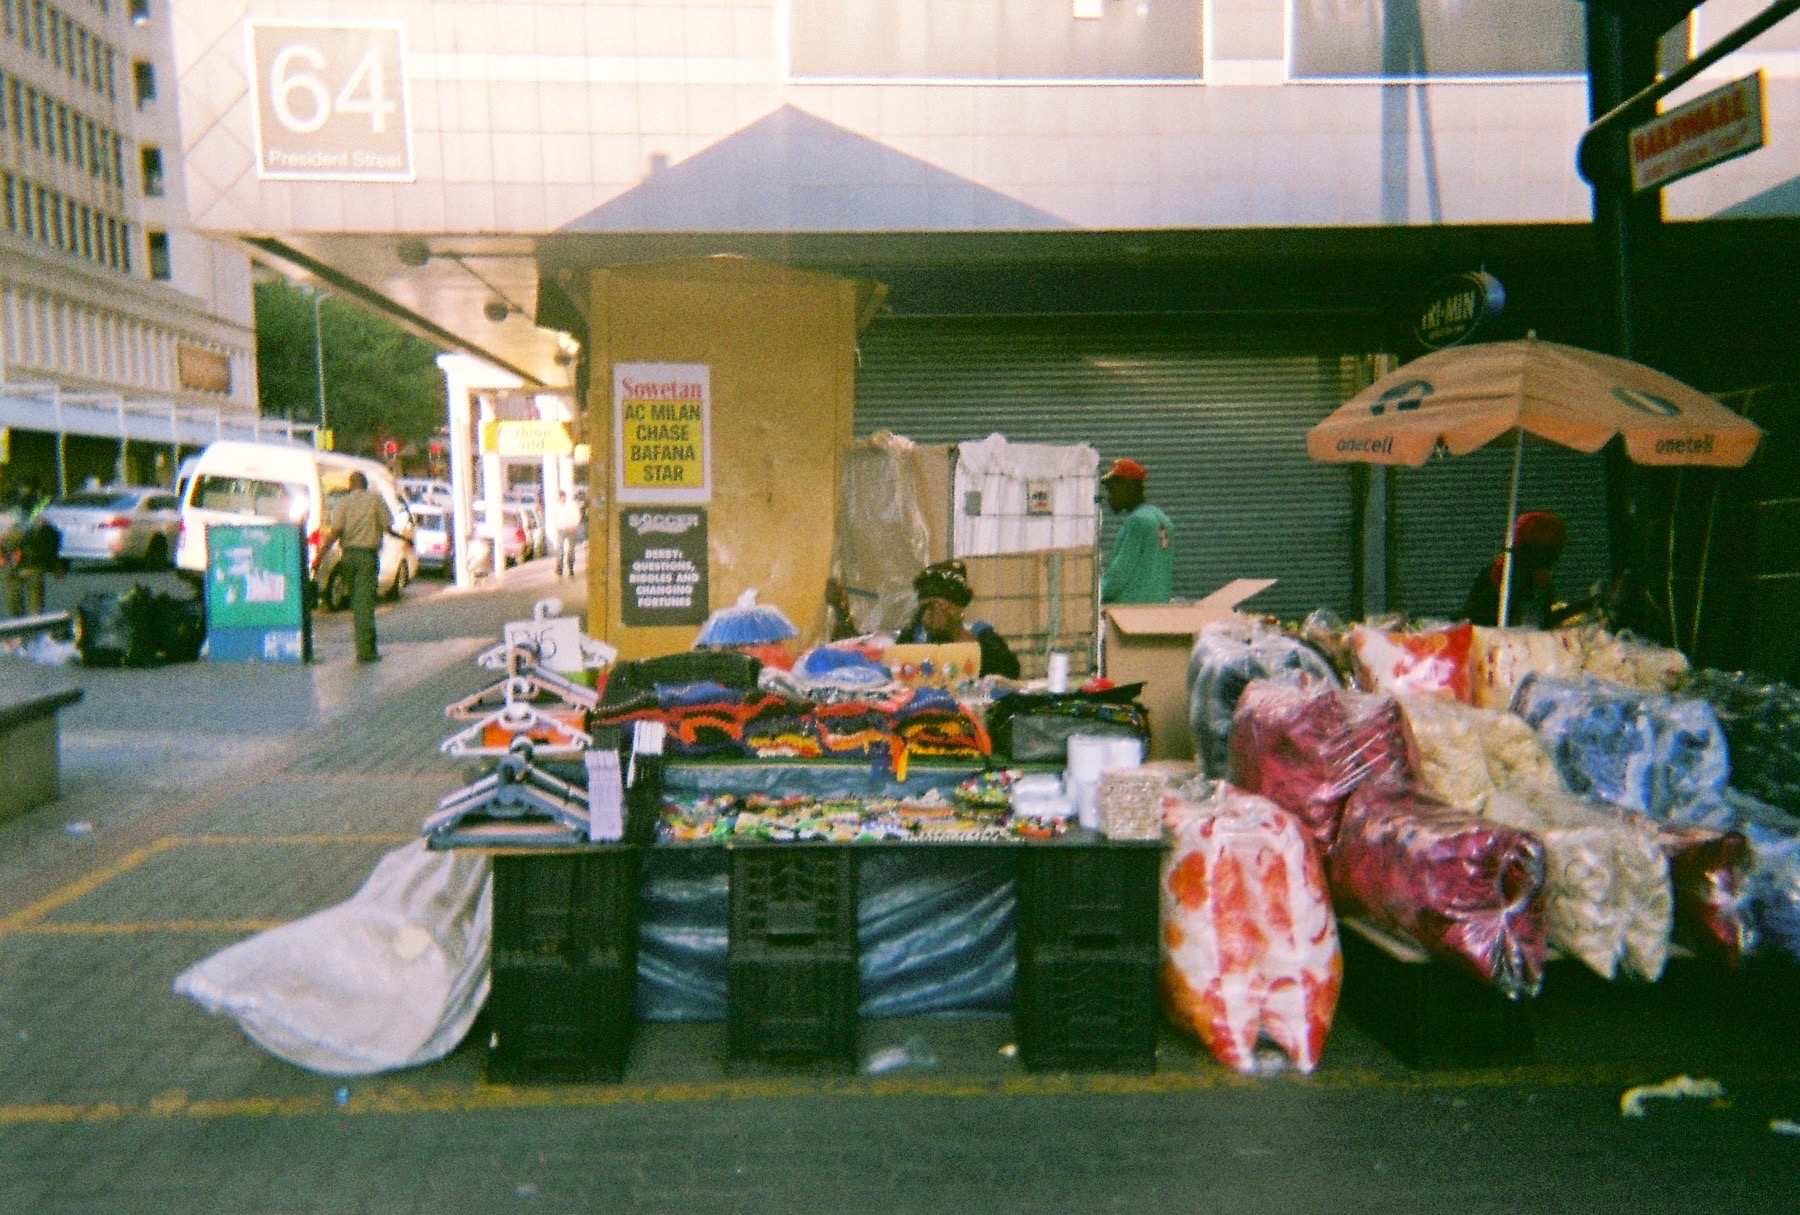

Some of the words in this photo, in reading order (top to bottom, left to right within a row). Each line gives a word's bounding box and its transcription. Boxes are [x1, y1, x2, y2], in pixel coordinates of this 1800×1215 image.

[270, 44, 397, 134] 64
[268, 147, 347, 167] President
[352, 150, 403, 168] Street
[622, 377, 703, 400] Sowetan
[624, 404, 645, 420] AC
[650, 404, 701, 421] MILAN
[636, 424, 689, 441] CHASE
[630, 444, 695, 461] BAFANA
[643, 464, 684, 481] STAR
[676, 573, 699, 583] AND
